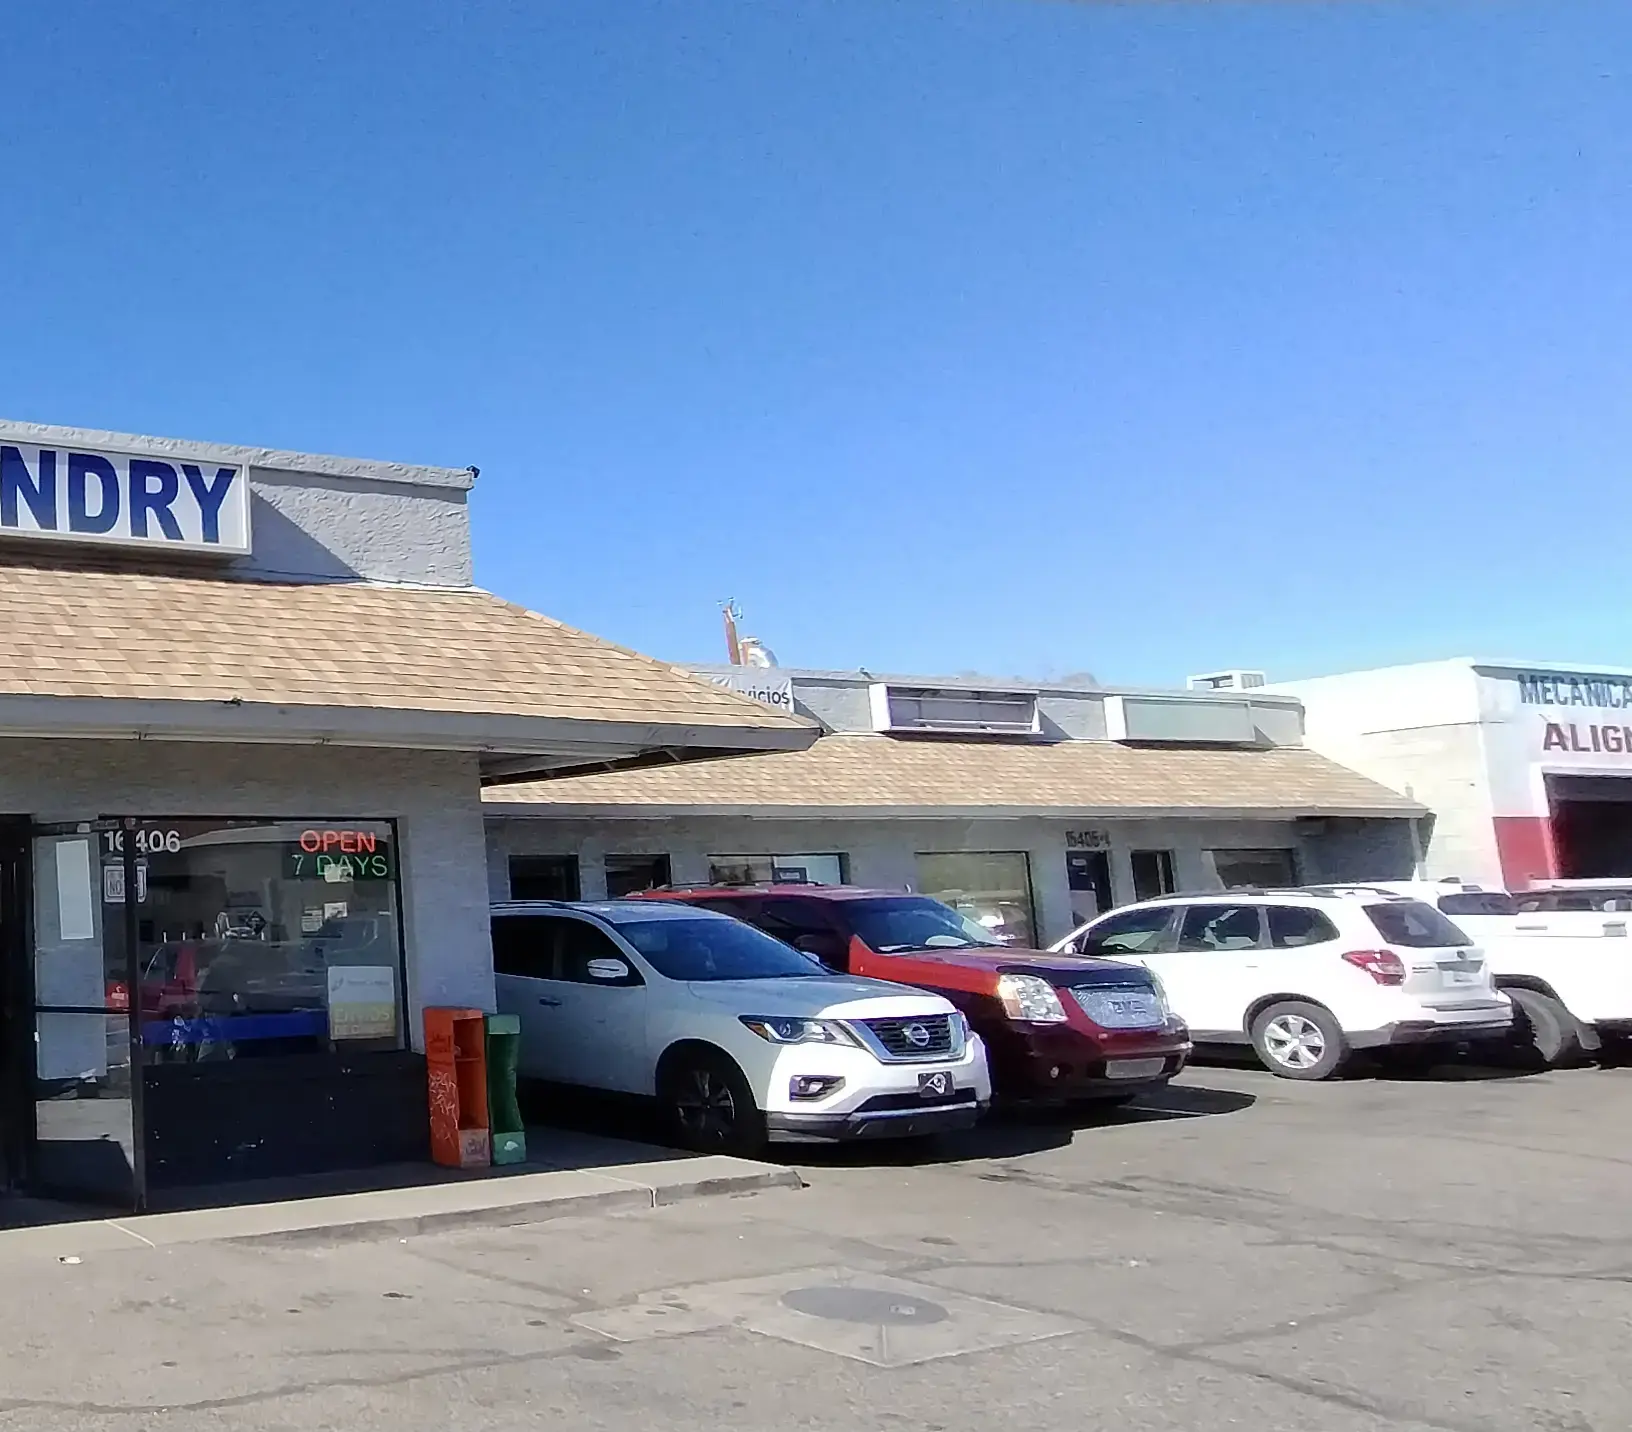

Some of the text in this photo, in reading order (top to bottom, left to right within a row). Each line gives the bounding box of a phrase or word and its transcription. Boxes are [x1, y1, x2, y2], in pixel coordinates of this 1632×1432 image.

[104, 829, 180, 853] 16406
[300, 829, 376, 852] OPEN
[291, 854, 388, 877] 7 DAYS
